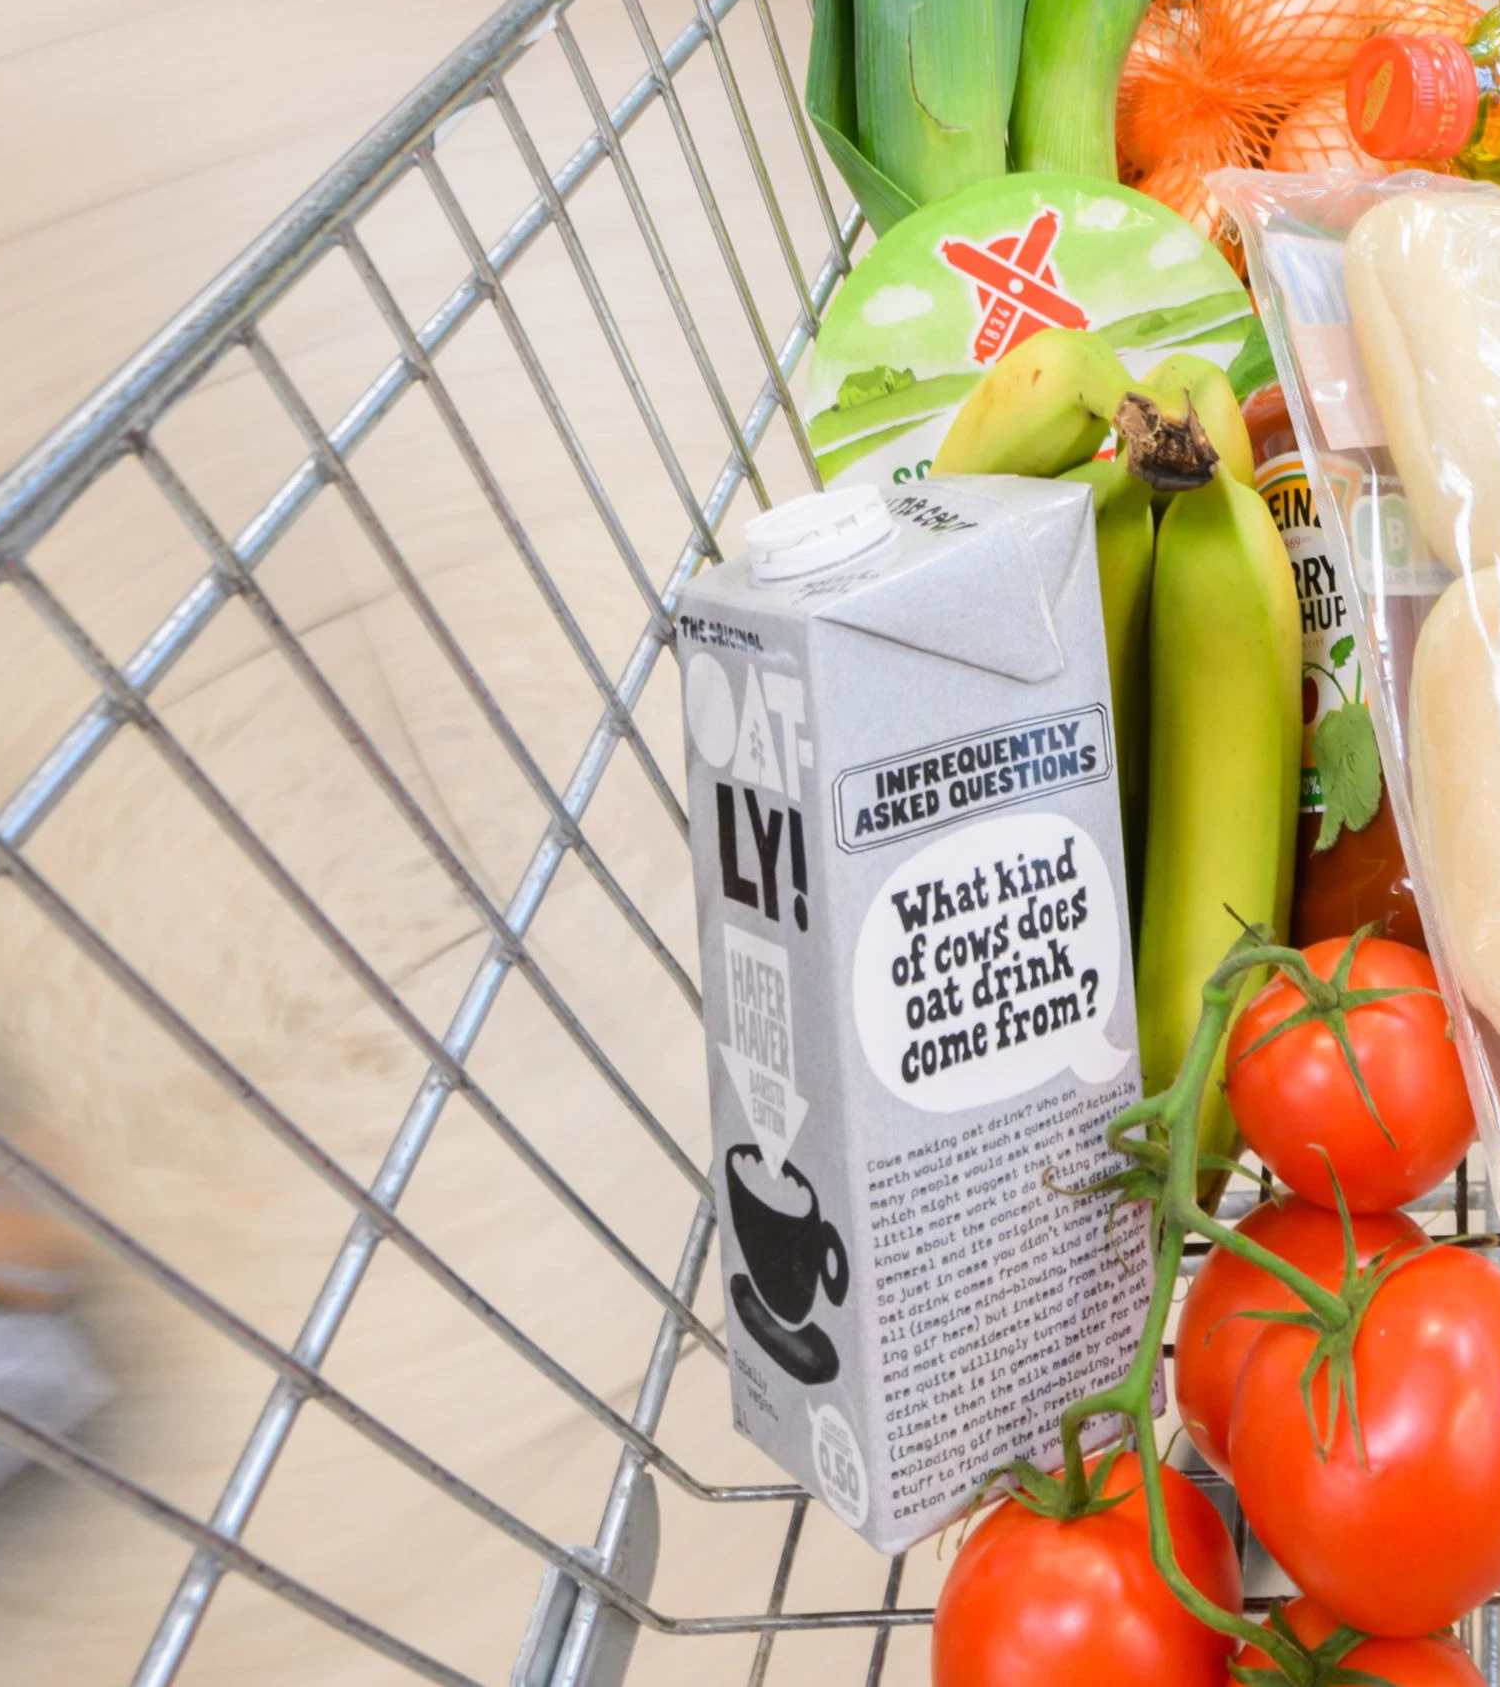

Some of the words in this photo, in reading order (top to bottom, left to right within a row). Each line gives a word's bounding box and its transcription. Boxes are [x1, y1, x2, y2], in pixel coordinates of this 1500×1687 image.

[979, 306, 1013, 349] 1834
[1268, 488, 1324, 532] EIN
[1291, 555, 1337, 600] RRY
[680, 615, 707, 644] THE
[709, 622, 764, 654] ORIGINAL
[854, 789, 940, 837] ASKED
[949, 744, 1097, 809] QUESTIONS
[875, 720, 1080, 800] INFREQUENTLY
[1302, 775, 1321, 795] 0%
[716, 783, 809, 932] LY!
[891, 866, 990, 933] What
[994, 836, 1077, 903] kind
[891, 933, 927, 987] of
[934, 914, 1010, 974] cows
[1017, 885, 1088, 940] does
[730, 949, 787, 1025] HAFER
[901, 1021, 989, 1084] come
[996, 968, 1099, 1052] from?
[906, 975, 964, 1030] oat
[972, 938, 1074, 1009] drink
[734, 1002, 791, 1082] HAVER
[866, 1155, 902, 1173] Cows
[907, 1136, 958, 1161] making
[962, 1123, 985, 1142] oat
[987, 1103, 1033, 1132] drink?
[1036, 1096, 1059, 1113] Who
[1061, 1089, 1077, 1103] on
[868, 1170, 911, 1192] earth
[913, 1155, 953, 1178] would
[956, 1146, 978, 1163] ask
[981, 1133, 1011, 1153] such
[1014, 1130, 1021, 1141] a
[1024, 1101, 1085, 1137] question?
[869, 1193, 906, 1211] many
[910, 1174, 960, 1201] people
[964, 1154, 1003, 1179] would
[1007, 1145, 1030, 1162] ask
[1034, 1131, 1064, 1151] such
[1067, 1127, 1075, 1138] a
[871, 1207, 916, 1231] which
[920, 1190, 961, 1214] might
[966, 1167, 1019, 1198] suggest
[1023, 1153, 1052, 1174] that
[1056, 1148, 1072, 1161] we
[1075, 1134, 1103, 1154] have
[873, 1225, 924, 1250] little
[928, 1212, 962, 1231] more
[965, 1196, 997, 1217] work
[1002, 1189, 1017, 1202] to
[1021, 1181, 1037, 1195] do
[1041, 1158, 1091, 1187] etting
[874, 1250, 910, 1269] know
[915, 1231, 957, 1256] about
[961, 1221, 985, 1238] the
[989, 1195, 1043, 1227] concept
[1088, 1161, 1121, 1184] drink
[876, 1257, 937, 1291] general
[941, 1246, 966, 1266] and
[971, 1237, 993, 1255] its
[998, 1213, 1050, 1243] origins
[1054, 1204, 1069, 1220] in
[877, 1293, 895, 1307] So
[899, 1279, 932, 1304] just
[936, 1273, 953, 1288] in
[956, 1259, 988, 1279] case
[992, 1247, 1016, 1267] you
[1019, 1225, 1060, 1253] didn't
[1063, 1214, 1093, 1233] know
[878, 1308, 905, 1326] oat
[908, 1293, 950, 1317] drink
[954, 1275, 994, 1300] comes
[998, 1260, 1029, 1281] from
[1032, 1252, 1048, 1266] no
[1051, 1235, 1081, 1257] kind
[1085, 1226, 1099, 1243] of
[1132, 1204, 1144, 1219] at
[880, 1326, 906, 1346] all
[909, 1304, 972, 1338] (imagine
[975, 1265, 1067, 1310] mind-blowing,
[882, 1348, 909, 1366] ing
[913, 1334, 938, 1357] gif
[942, 1314, 980, 1343] here)
[985, 1306, 1009, 1326] but
[1013, 1281, 1064, 1314] instead
[1067, 1268, 1097, 1288] from
[1122, 1238, 1146, 1261] best
[883, 1365, 910, 1384] and
[913, 1352, 946, 1373] most
[949, 1317, 1031, 1360] considerate
[1033, 1300, 1063, 1323] kind
[1066, 1291, 1080, 1308] of
[1083, 1280, 1115, 1300] oats,
[884, 1387, 911, 1403] are
[915, 1370, 956, 1394] quite
[960, 1337, 1029, 1375] willingly
[1033, 1312, 1077, 1342] turned
[1081, 1299, 1109, 1321] into
[1112, 1290, 1126, 1305] an
[1128, 1276, 1147, 1295] oat
[885, 1399, 929, 1423] drink
[933, 1383, 965, 1406] that
[970, 1376, 985, 1392] is
[990, 1367, 1006, 1382] in
[1009, 1339, 1061, 1376] general
[1064, 1319, 1106, 1347] better
[1110, 1307, 1130, 1324] for
[1132, 1295, 1150, 1311] the
[886, 1412, 948, 1442] climate
[953, 1395, 986, 1417] than
[990, 1383, 1013, 1400] the
[1017, 1365, 1049, 1387] milk
[1052, 1350, 1082, 1371] made
[1086, 1341, 1101, 1356] by
[1104, 1325, 1132, 1346] cows
[889, 1428, 957, 1463] (imagine
[962, 1400, 1017, 1433] another
[1020, 1356, 1115, 1405] mind-blowing,
[890, 1444, 966, 1481] exploding
[970, 1428, 992, 1451] gif
[1043, 1385, 1086, 1413] Pretty
[818, 1440, 861, 1502] 0.50
[892, 1474, 934, 1500] stuff
[938, 1468, 955, 1483] to
[958, 1449, 989, 1473] find
[992, 1442, 1008, 1457] on
[1011, 1430, 1034, 1448] the
[1037, 1415, 1060, 1435] sid
[893, 1491, 946, 1520] carton
[950, 1482, 967, 1497] we
